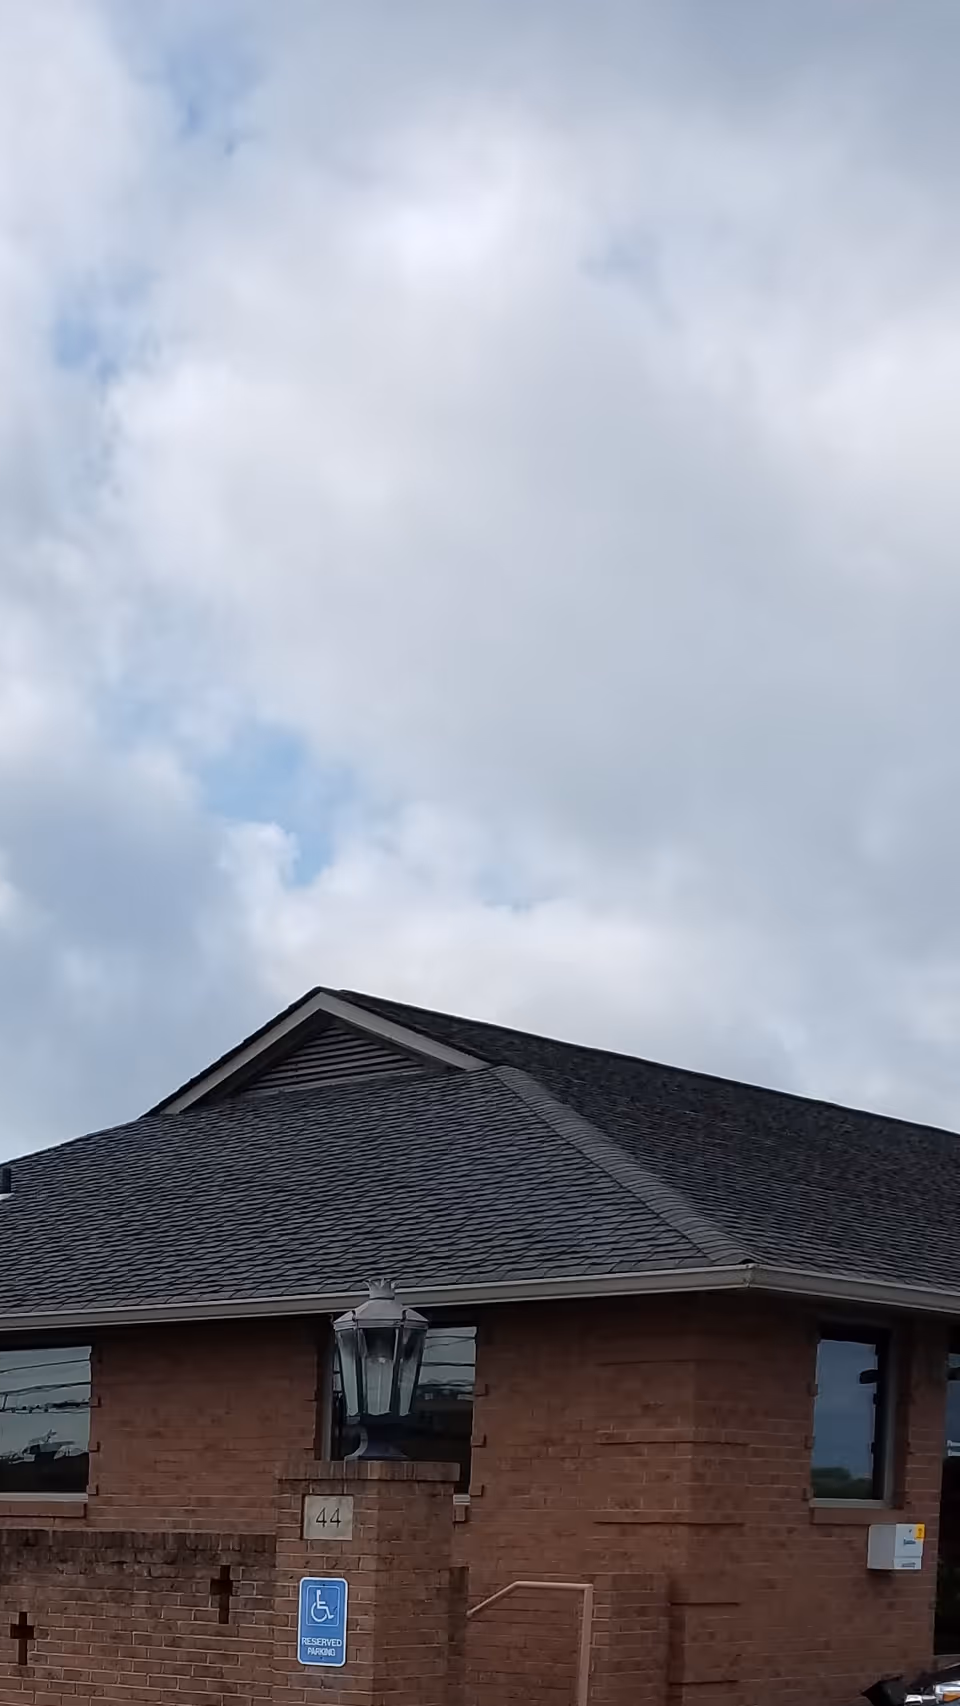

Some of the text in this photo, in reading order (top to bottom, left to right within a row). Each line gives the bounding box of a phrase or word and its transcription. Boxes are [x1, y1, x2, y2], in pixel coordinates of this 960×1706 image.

[315, 1507, 342, 1529] 44
[302, 1637, 342, 1647] RESERVED
[307, 1647, 336, 1657] PARKING
